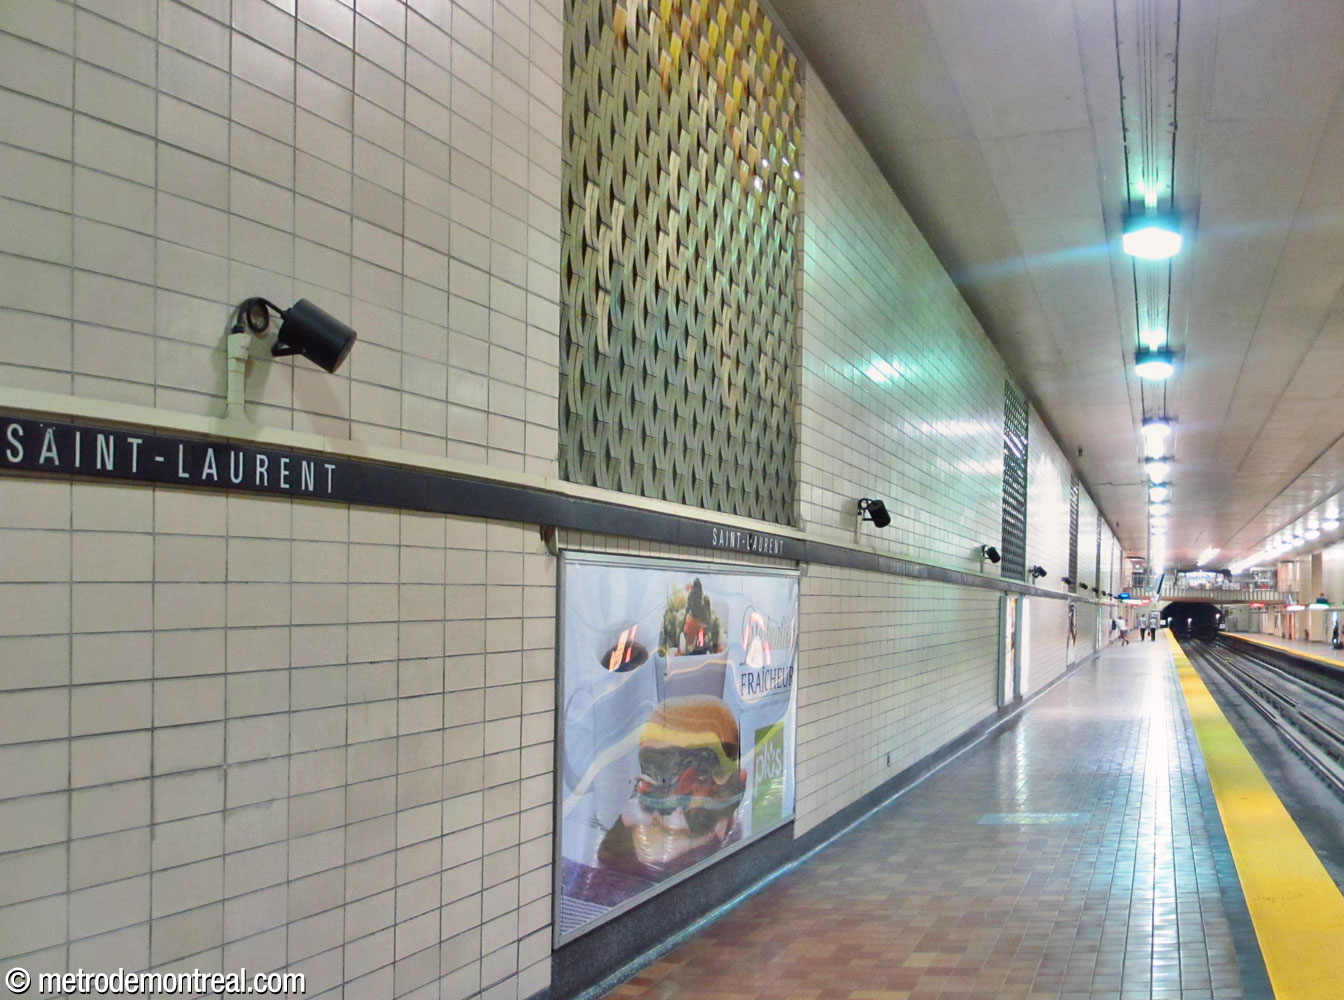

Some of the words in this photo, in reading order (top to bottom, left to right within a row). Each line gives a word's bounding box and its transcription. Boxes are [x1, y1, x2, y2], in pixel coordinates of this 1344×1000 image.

[5, 422, 337, 494] SAINT-LAURENT
[712, 527, 784, 555] SAINT-LAURENT
[740, 665, 794, 697] FRAÎCHEUR
